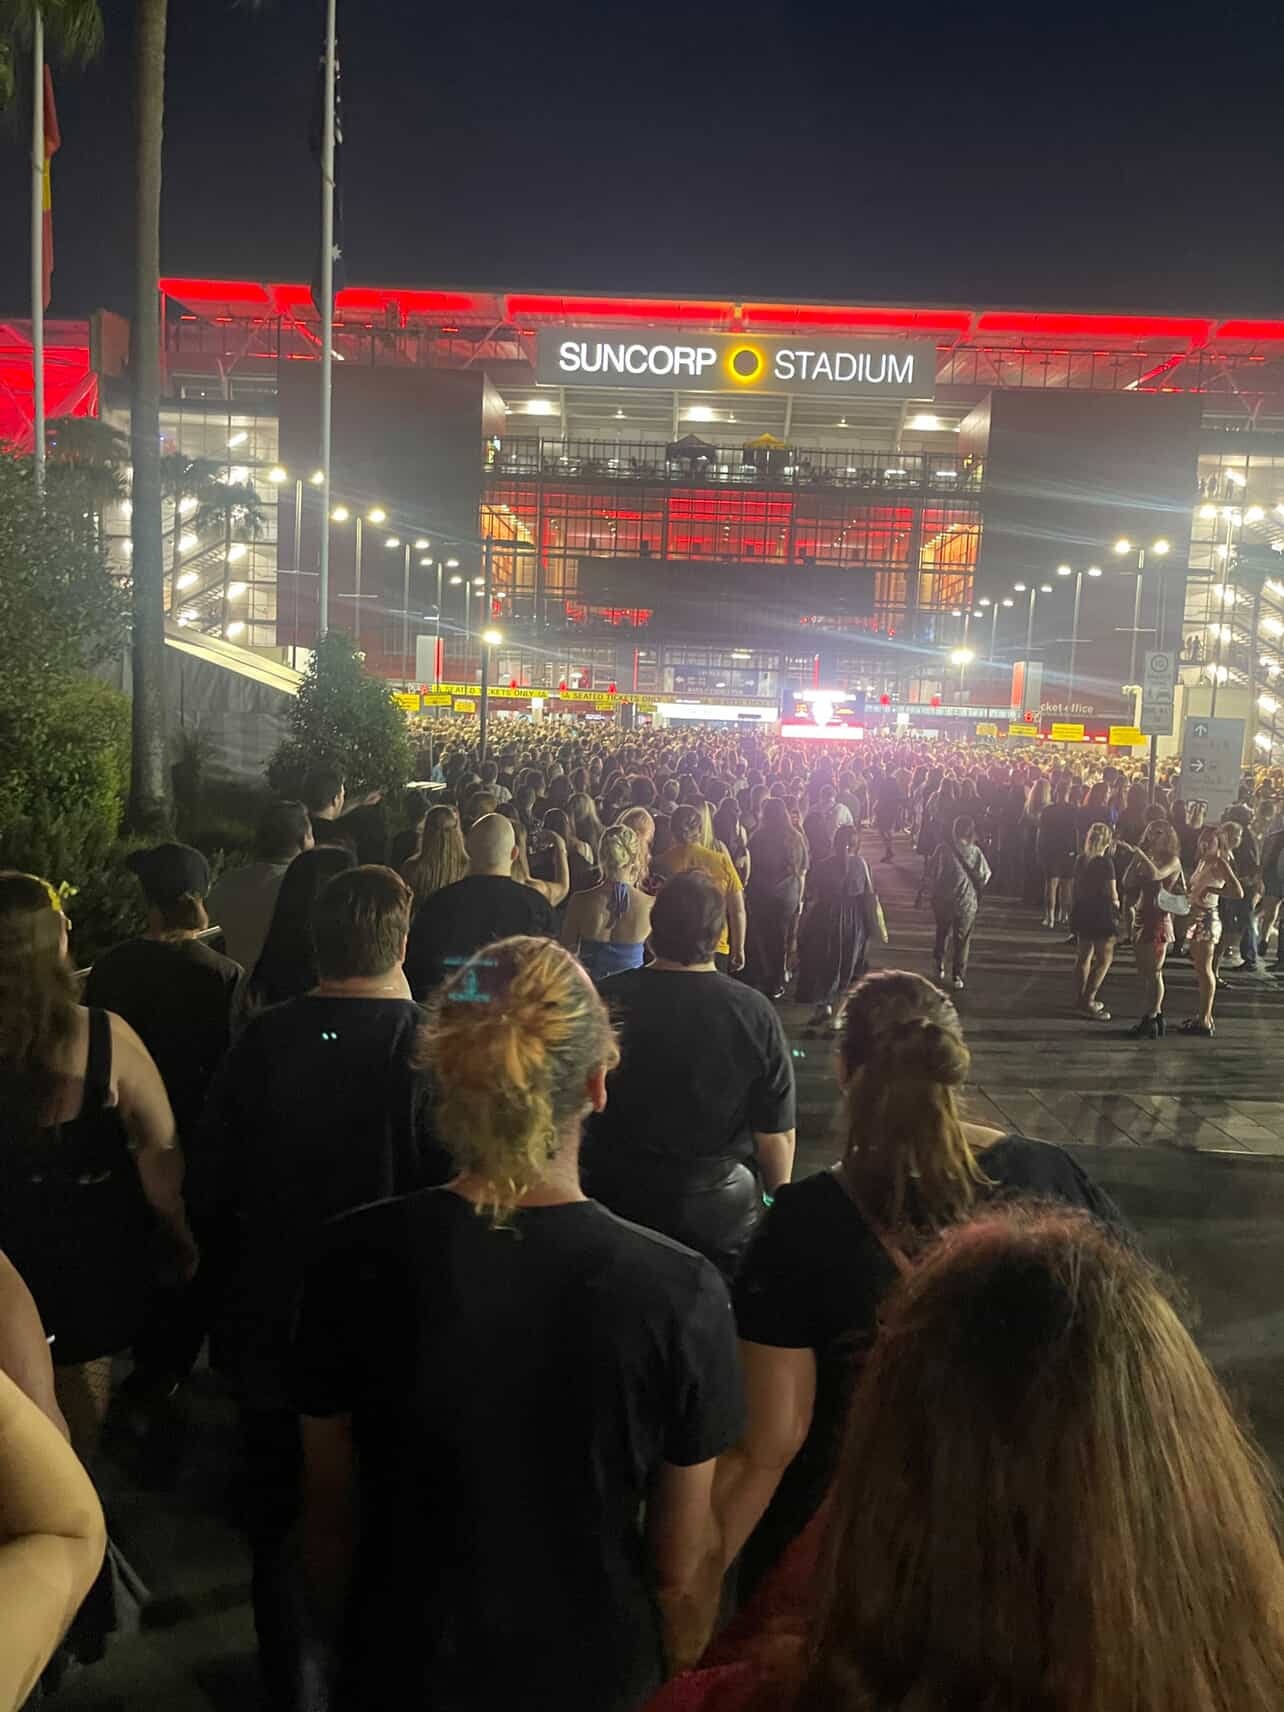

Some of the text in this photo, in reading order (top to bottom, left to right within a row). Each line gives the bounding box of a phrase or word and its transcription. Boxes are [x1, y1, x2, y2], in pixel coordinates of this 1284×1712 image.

[559, 341, 914, 384] SUNCORP STADIUM
[1040, 701, 1062, 713] cket
